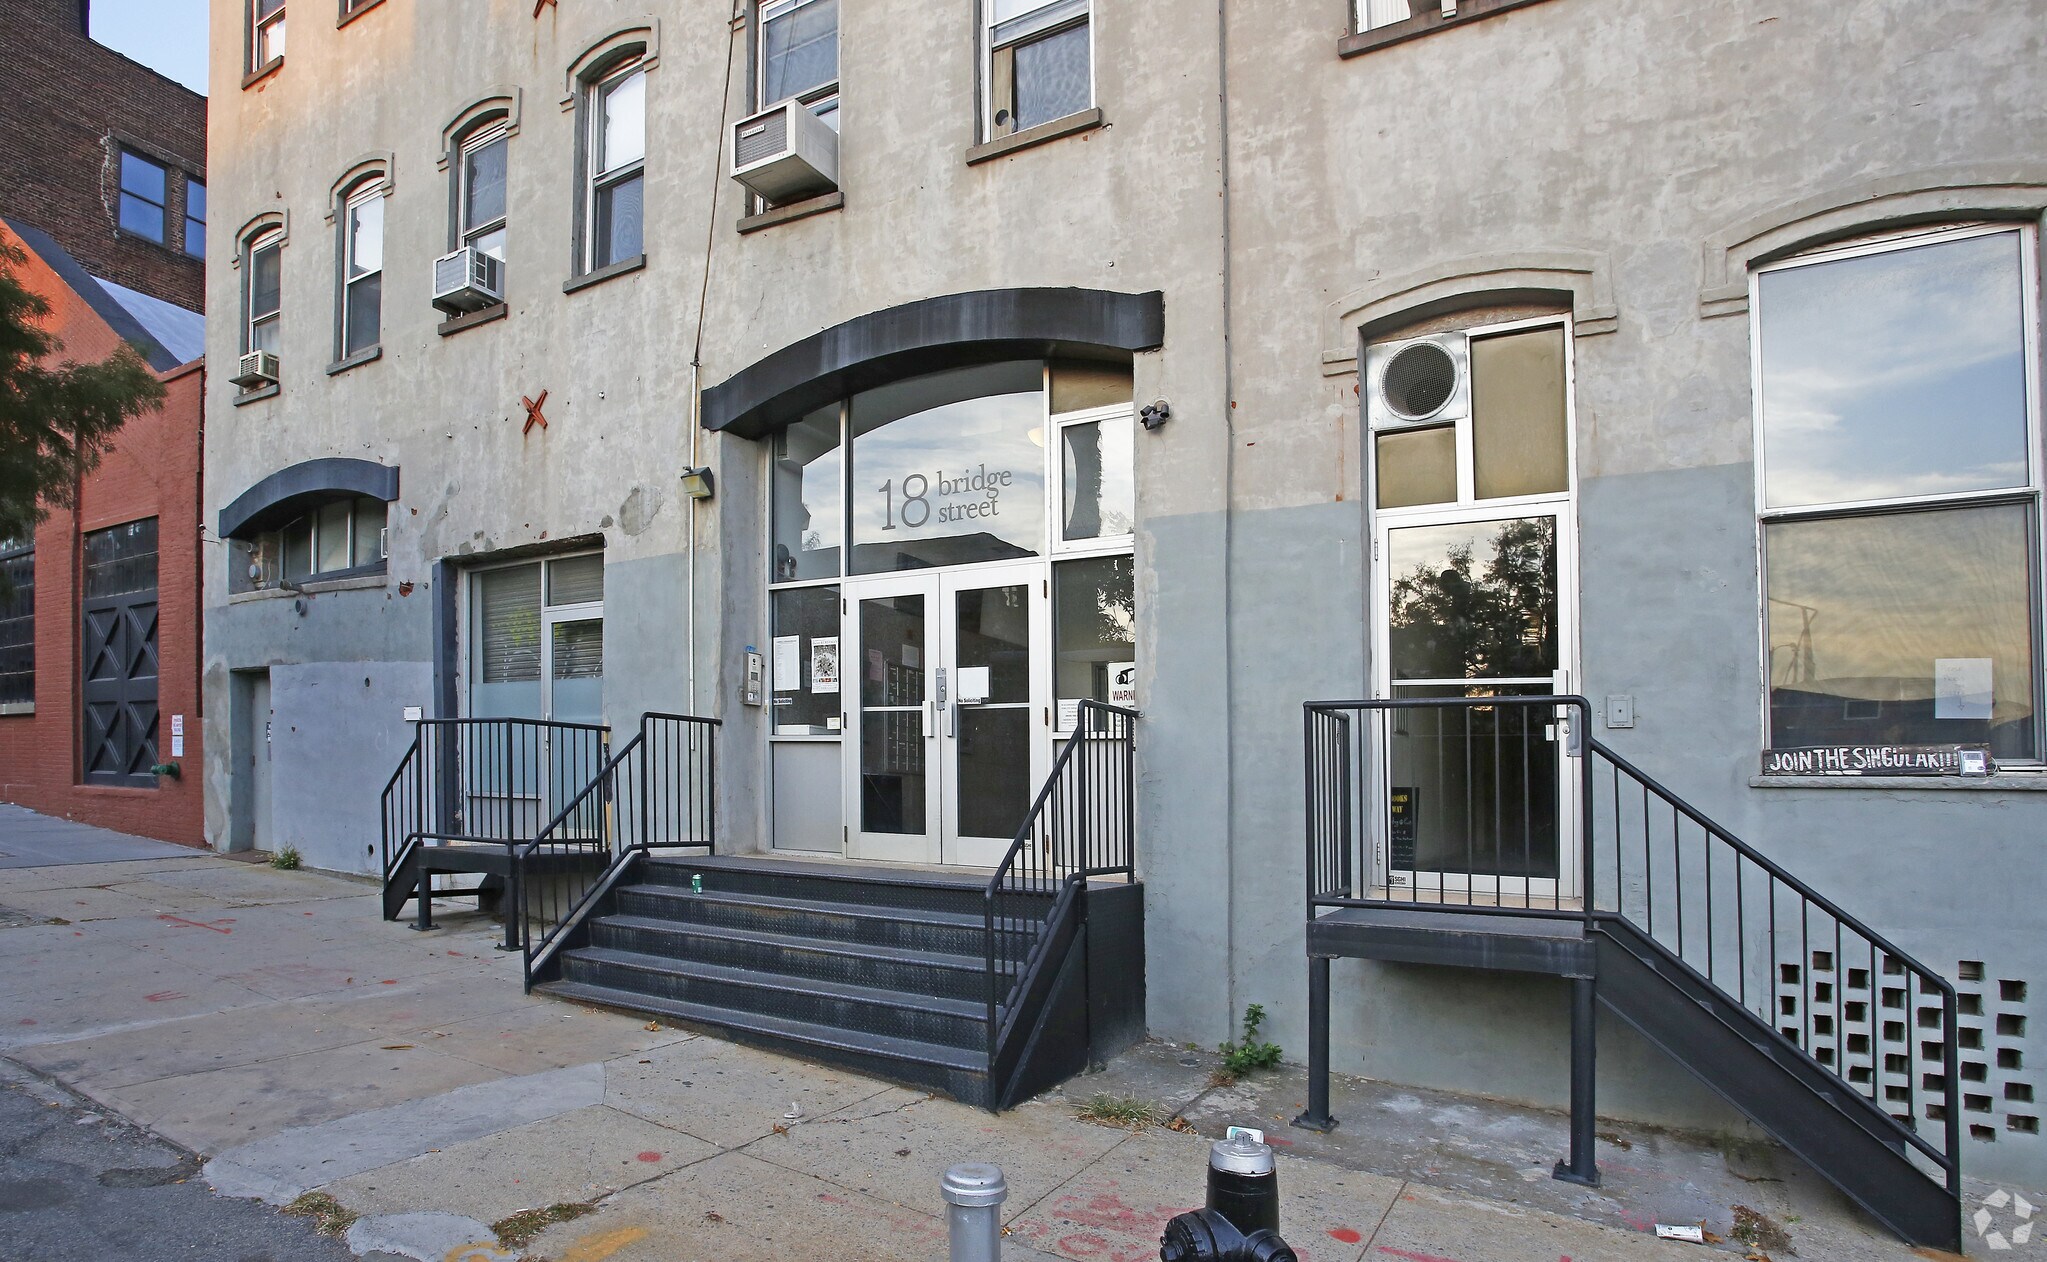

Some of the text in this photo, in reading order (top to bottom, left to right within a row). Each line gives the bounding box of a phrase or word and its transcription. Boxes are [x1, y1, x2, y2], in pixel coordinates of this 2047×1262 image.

[936, 463, 1012, 499] bridge
[878, 474, 931, 531] 18
[938, 499, 1000, 524] street
[1769, 751, 1812, 771] JOIN
[1813, 748, 1850, 769] THE
